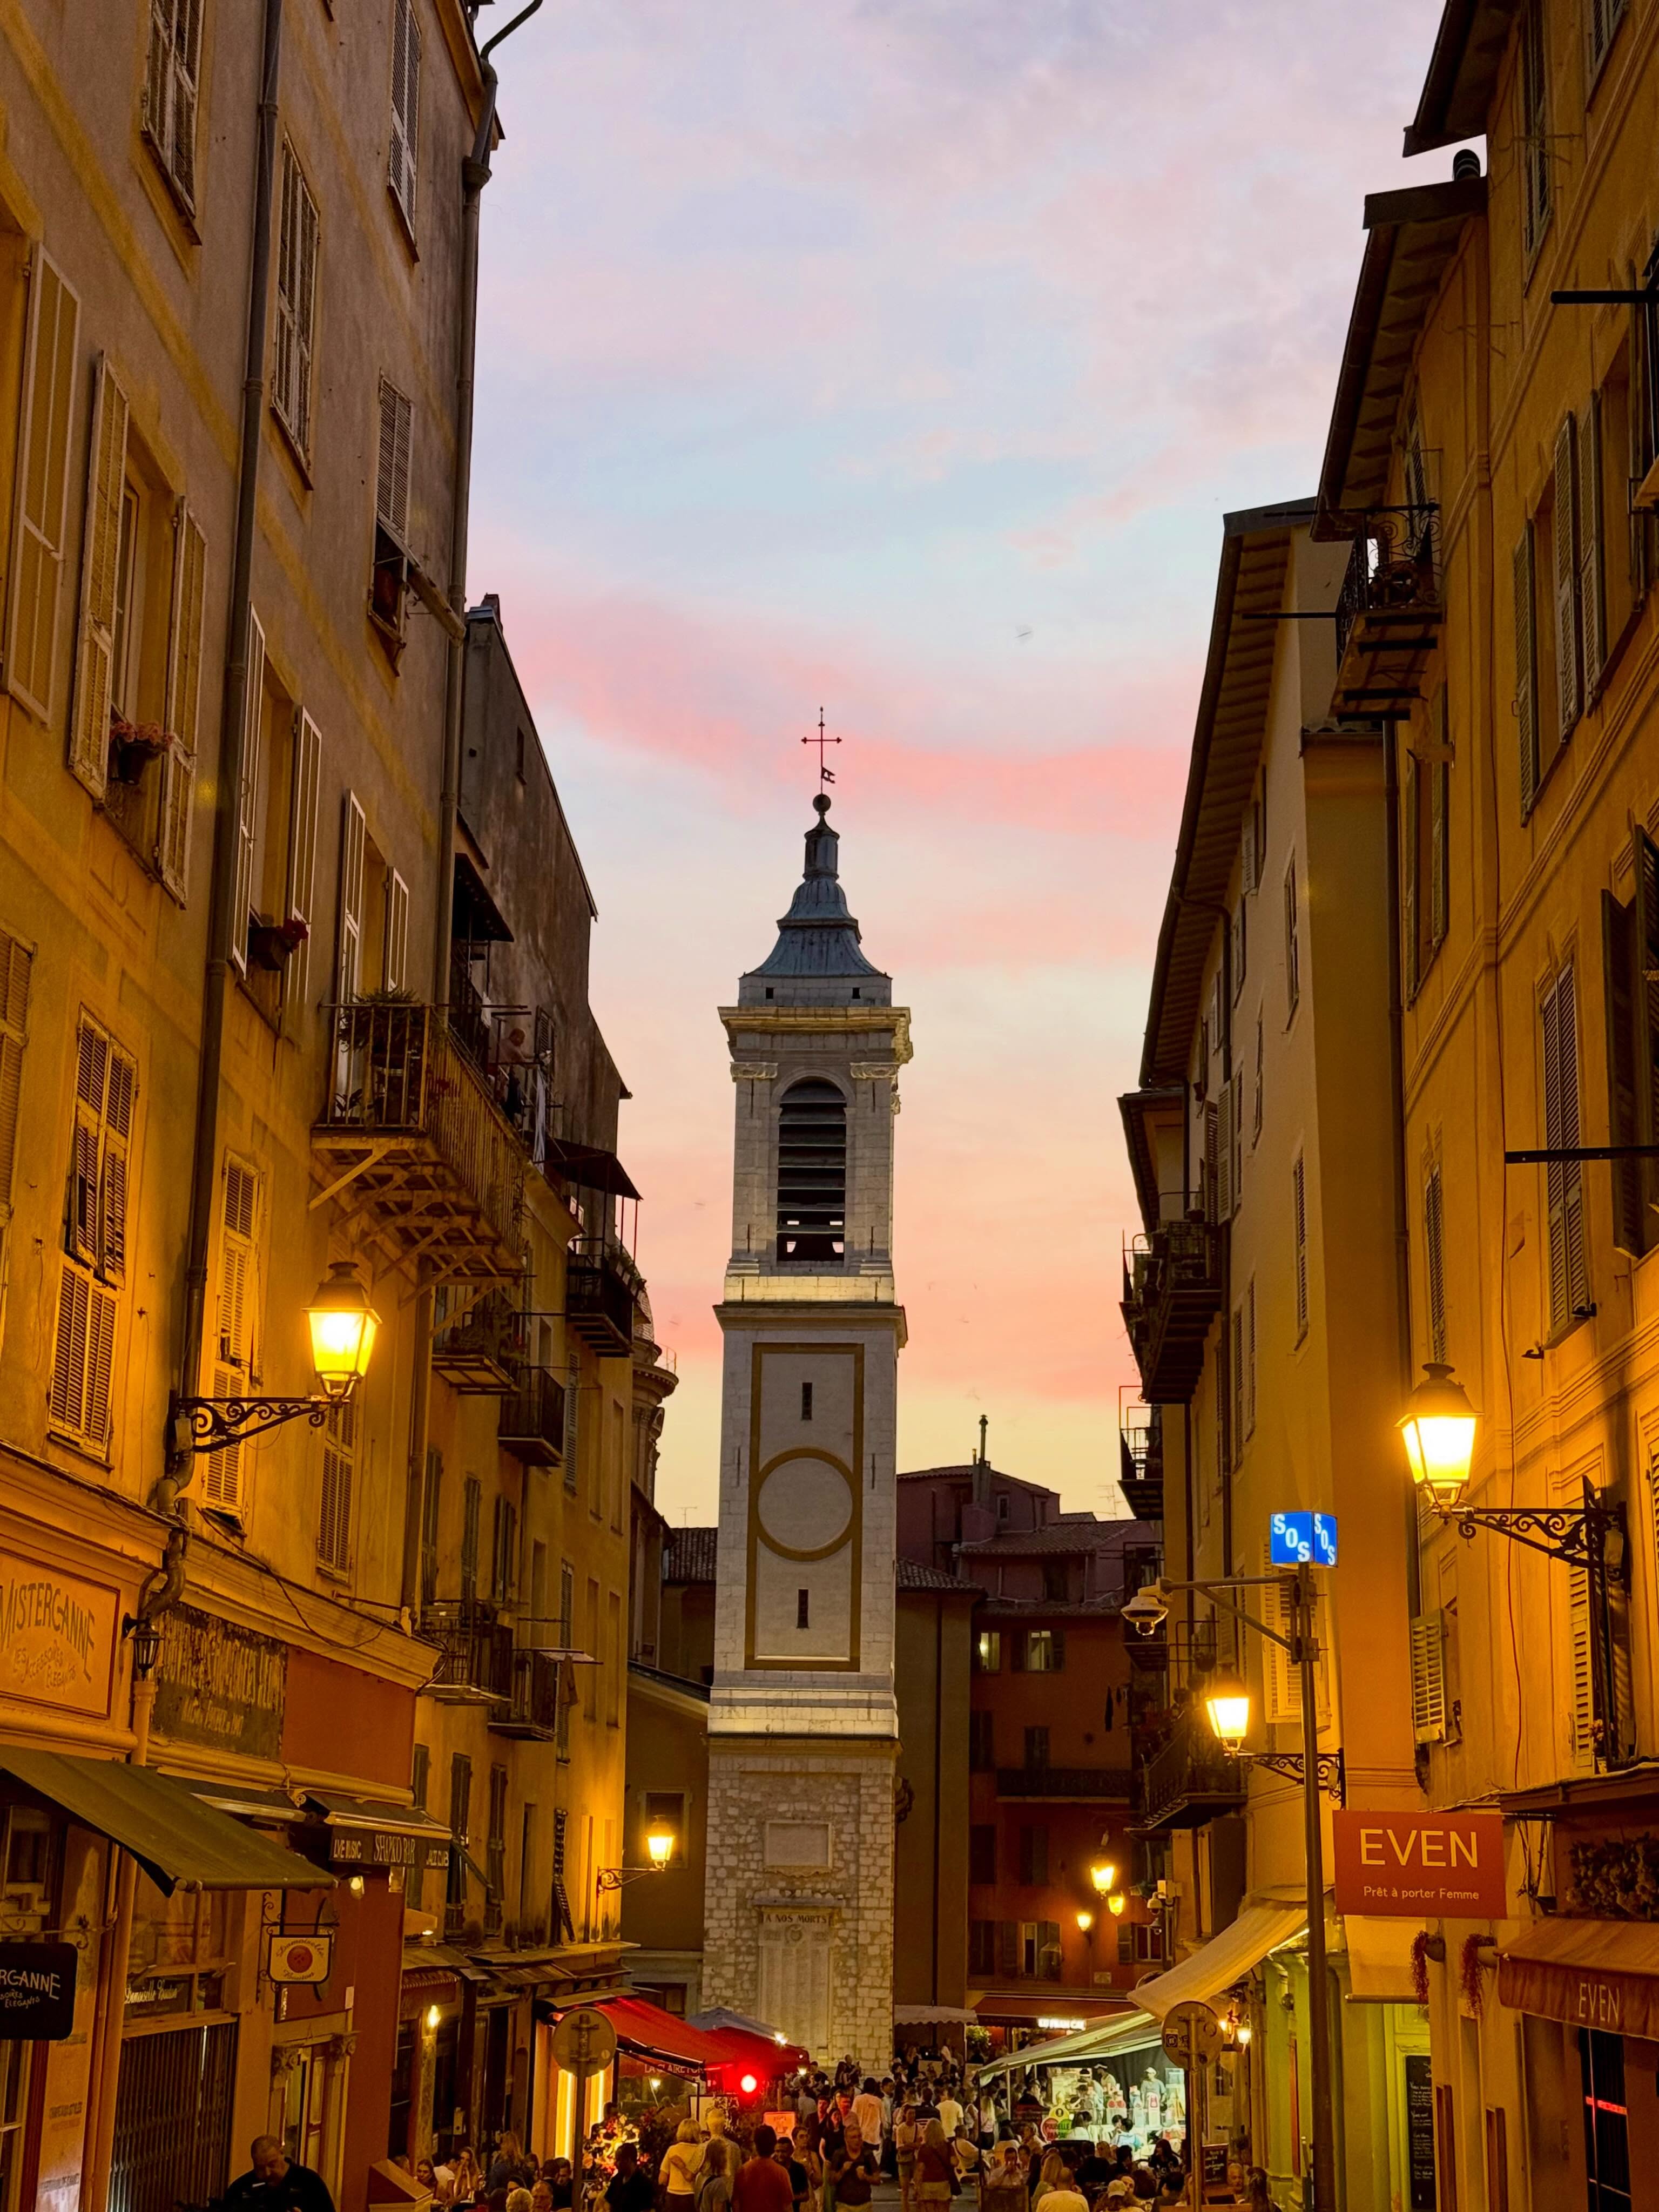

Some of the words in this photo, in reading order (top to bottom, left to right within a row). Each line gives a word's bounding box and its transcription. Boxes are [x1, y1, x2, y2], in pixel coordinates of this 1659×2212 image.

[1273, 1513, 1310, 1562] SOS
[1314, 1513, 1336, 1566] SOS
[1360, 1829, 1478, 1868] EVEN
[1364, 1886, 1388, 1897] Prêt
[1391, 1887, 1398, 1897] à
[1402, 1889, 1435, 1899] porter
[1439, 1888, 1479, 1899] Femme
[775, 1914, 793, 1923] NOS
[798, 1914, 827, 1924] MORTS
[1579, 1982, 1620, 2025] EVEN
